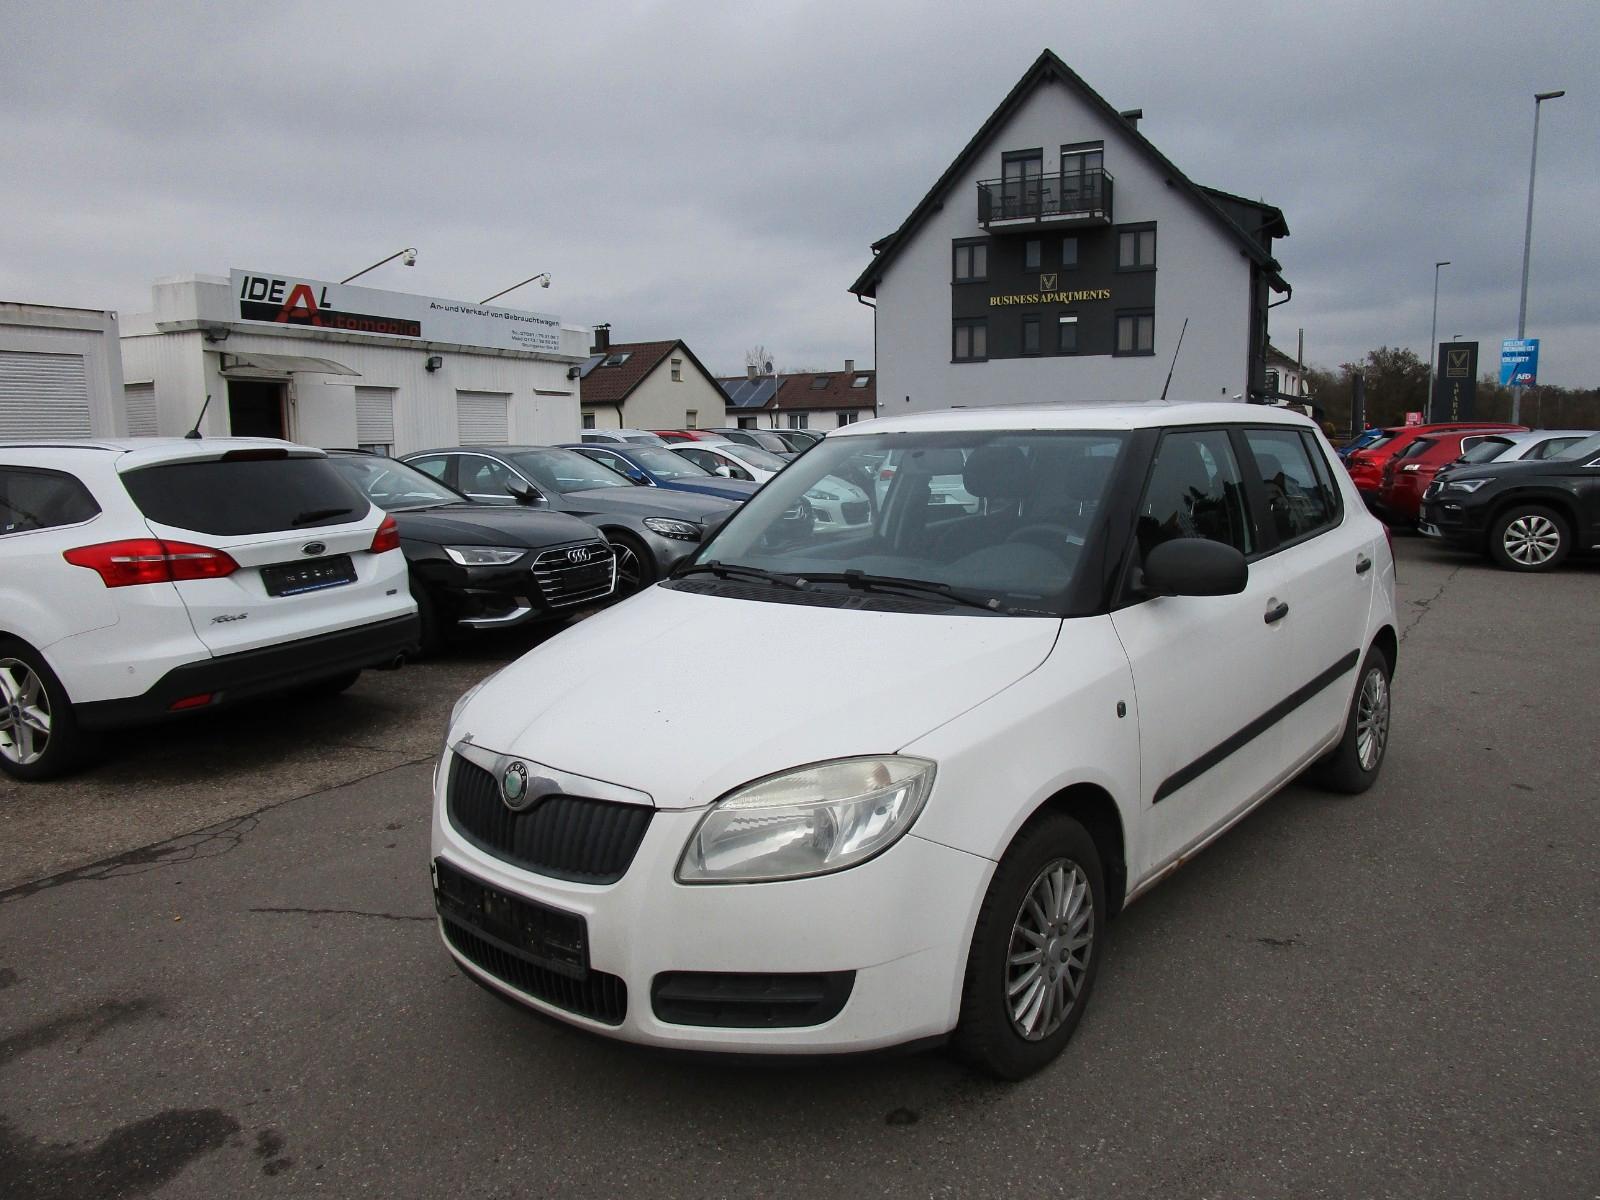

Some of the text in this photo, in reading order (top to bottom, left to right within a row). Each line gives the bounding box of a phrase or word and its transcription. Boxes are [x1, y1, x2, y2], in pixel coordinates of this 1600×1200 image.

[240, 276, 332, 326] IDEAL
[989, 289, 1111, 306] BUSINESS APARTMENTS
[460, 306, 489, 317] Verkauf
[504, 312, 560, 327] Gebrauchtwagen
